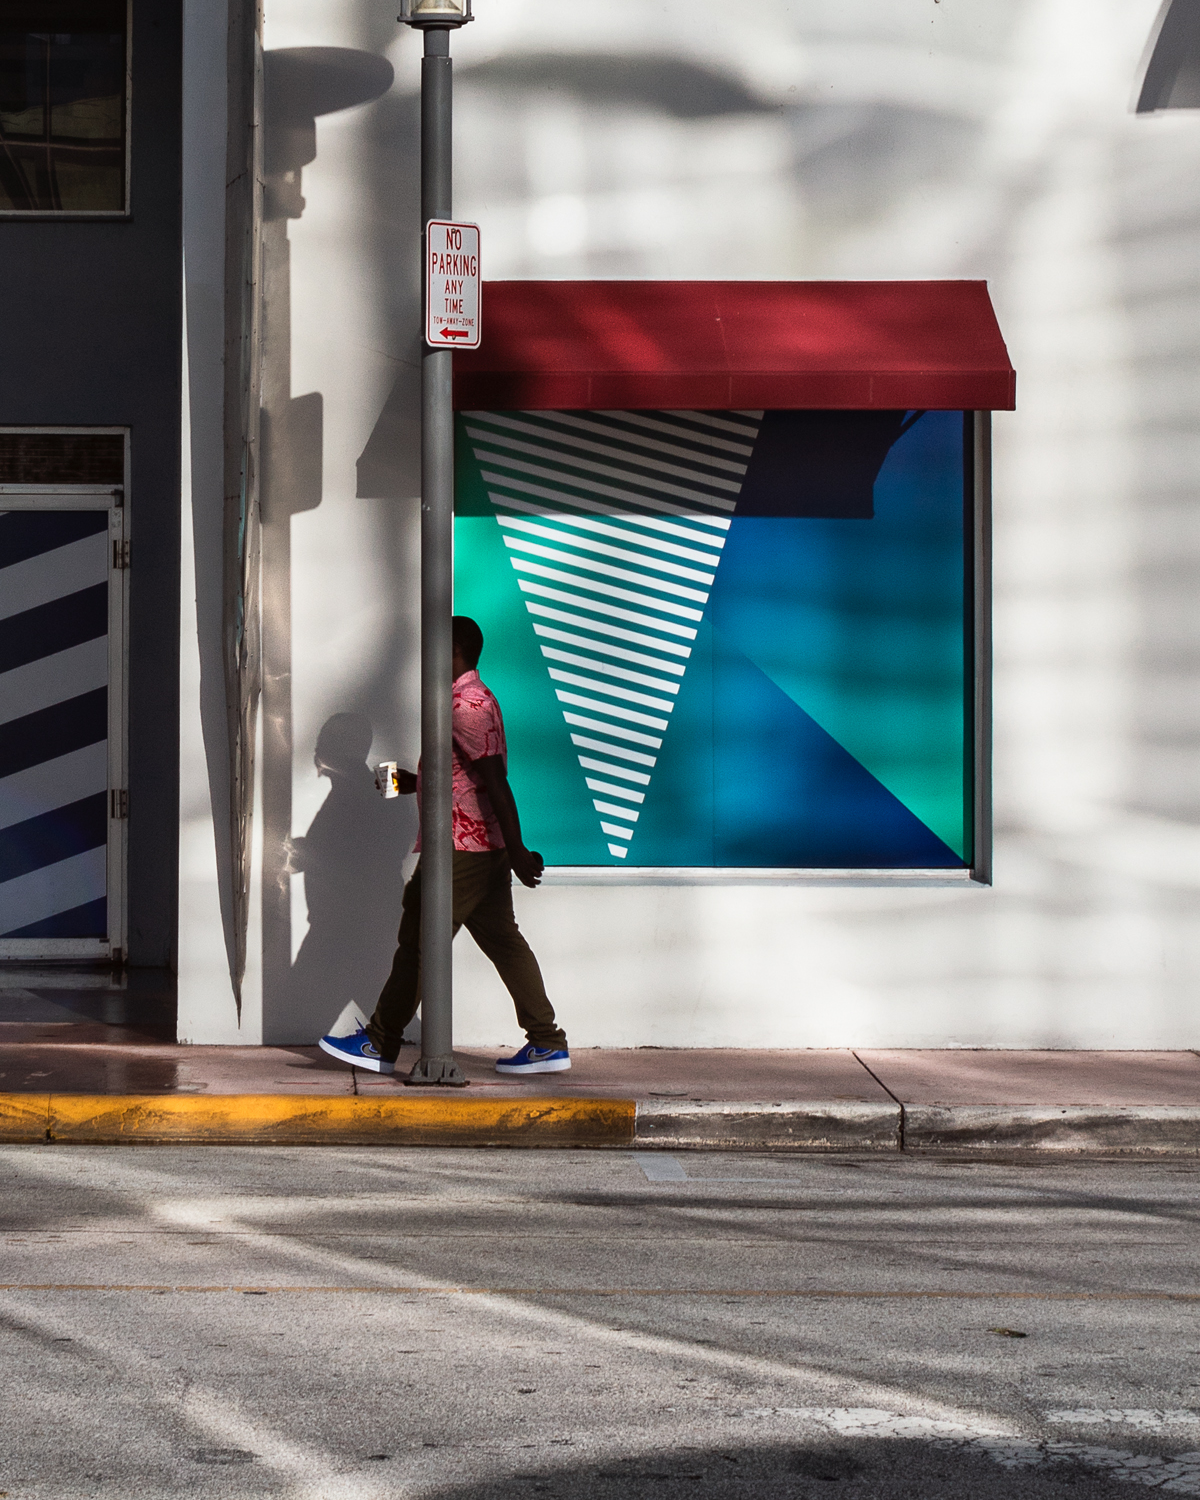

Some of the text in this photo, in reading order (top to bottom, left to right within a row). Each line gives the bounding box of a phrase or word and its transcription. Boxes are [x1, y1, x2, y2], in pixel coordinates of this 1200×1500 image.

[446, 228, 462, 250] NO
[432, 252, 477, 277] PARKING
[444, 279, 464, 295] ANY
[444, 298, 464, 314] TIME
[433, 316, 475, 327] TOW-AWAY-ZONE
